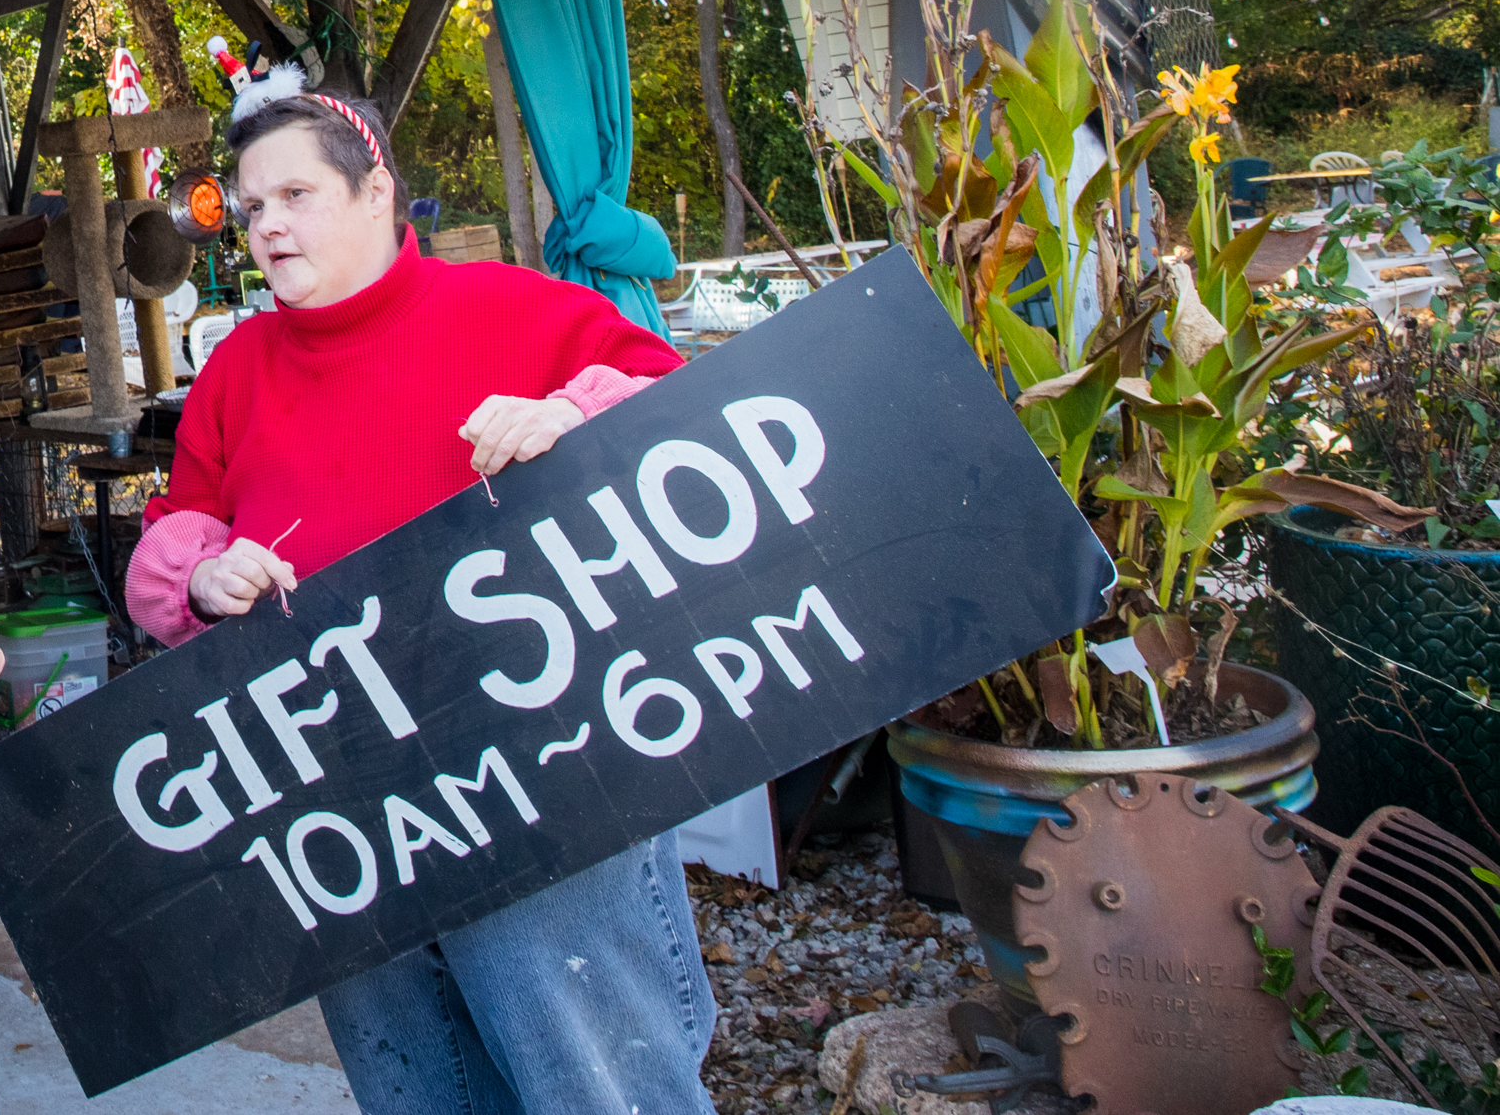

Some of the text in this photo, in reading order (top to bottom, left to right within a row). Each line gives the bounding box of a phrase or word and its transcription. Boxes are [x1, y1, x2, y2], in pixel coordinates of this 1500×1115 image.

[112, 394, 827, 852] GIFT SHOP
[1096, 988, 1133, 1008] DRY
[1151, 993, 1199, 1015] PIPE
